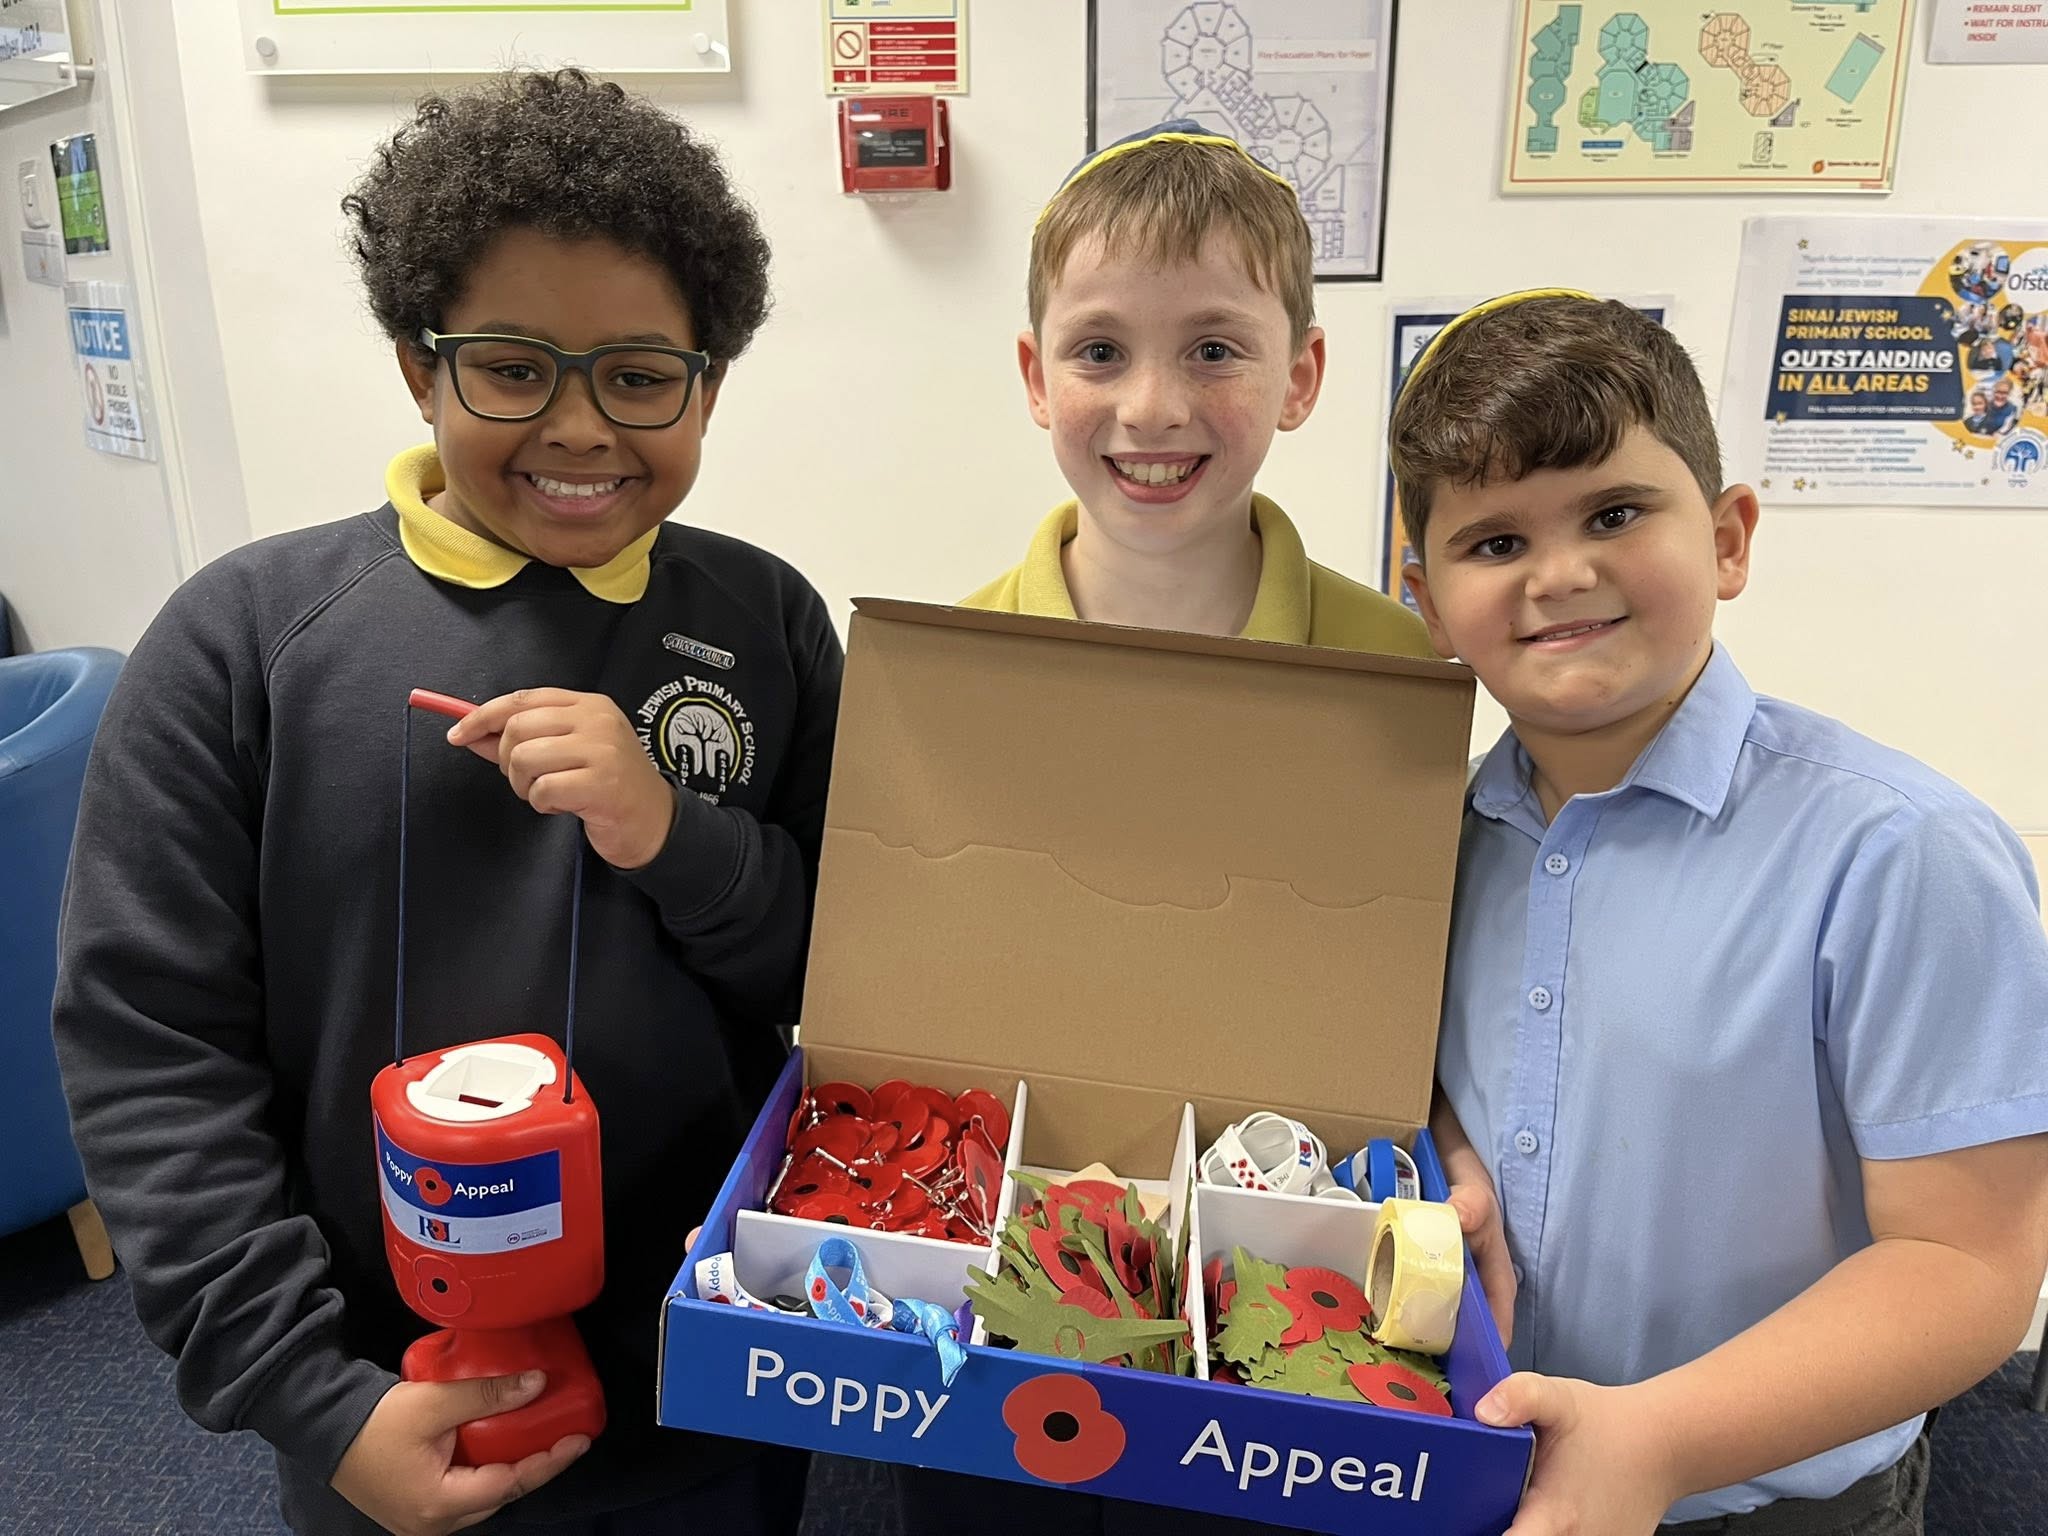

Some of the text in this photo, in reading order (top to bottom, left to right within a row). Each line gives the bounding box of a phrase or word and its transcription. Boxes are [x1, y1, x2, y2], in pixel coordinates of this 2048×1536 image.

[1973, 5, 2042, 13] REMAIN SILENT
[1971, 19, 1994, 27] WAIT
[1967, 33, 1997, 41] INSIDE
[1788, 309, 1898, 323] SINAI JEWISH
[73, 319, 123, 352] NOTICE
[1785, 325, 1933, 340] PRIMARY SCHOOL
[1781, 350, 1954, 369] OUTSTANDING
[1778, 374, 1930, 392] IN ALL AREAS
[637, 680, 683, 724] JEWISH
[684, 675, 747, 719] PRIMARY
[738, 721, 756, 786] SCHOOL
[386, 1151, 514, 1200] Poppy Appeal
[708, 1256, 722, 1293] Poppy
[745, 1346, 1432, 1505] Poppy Appeal
